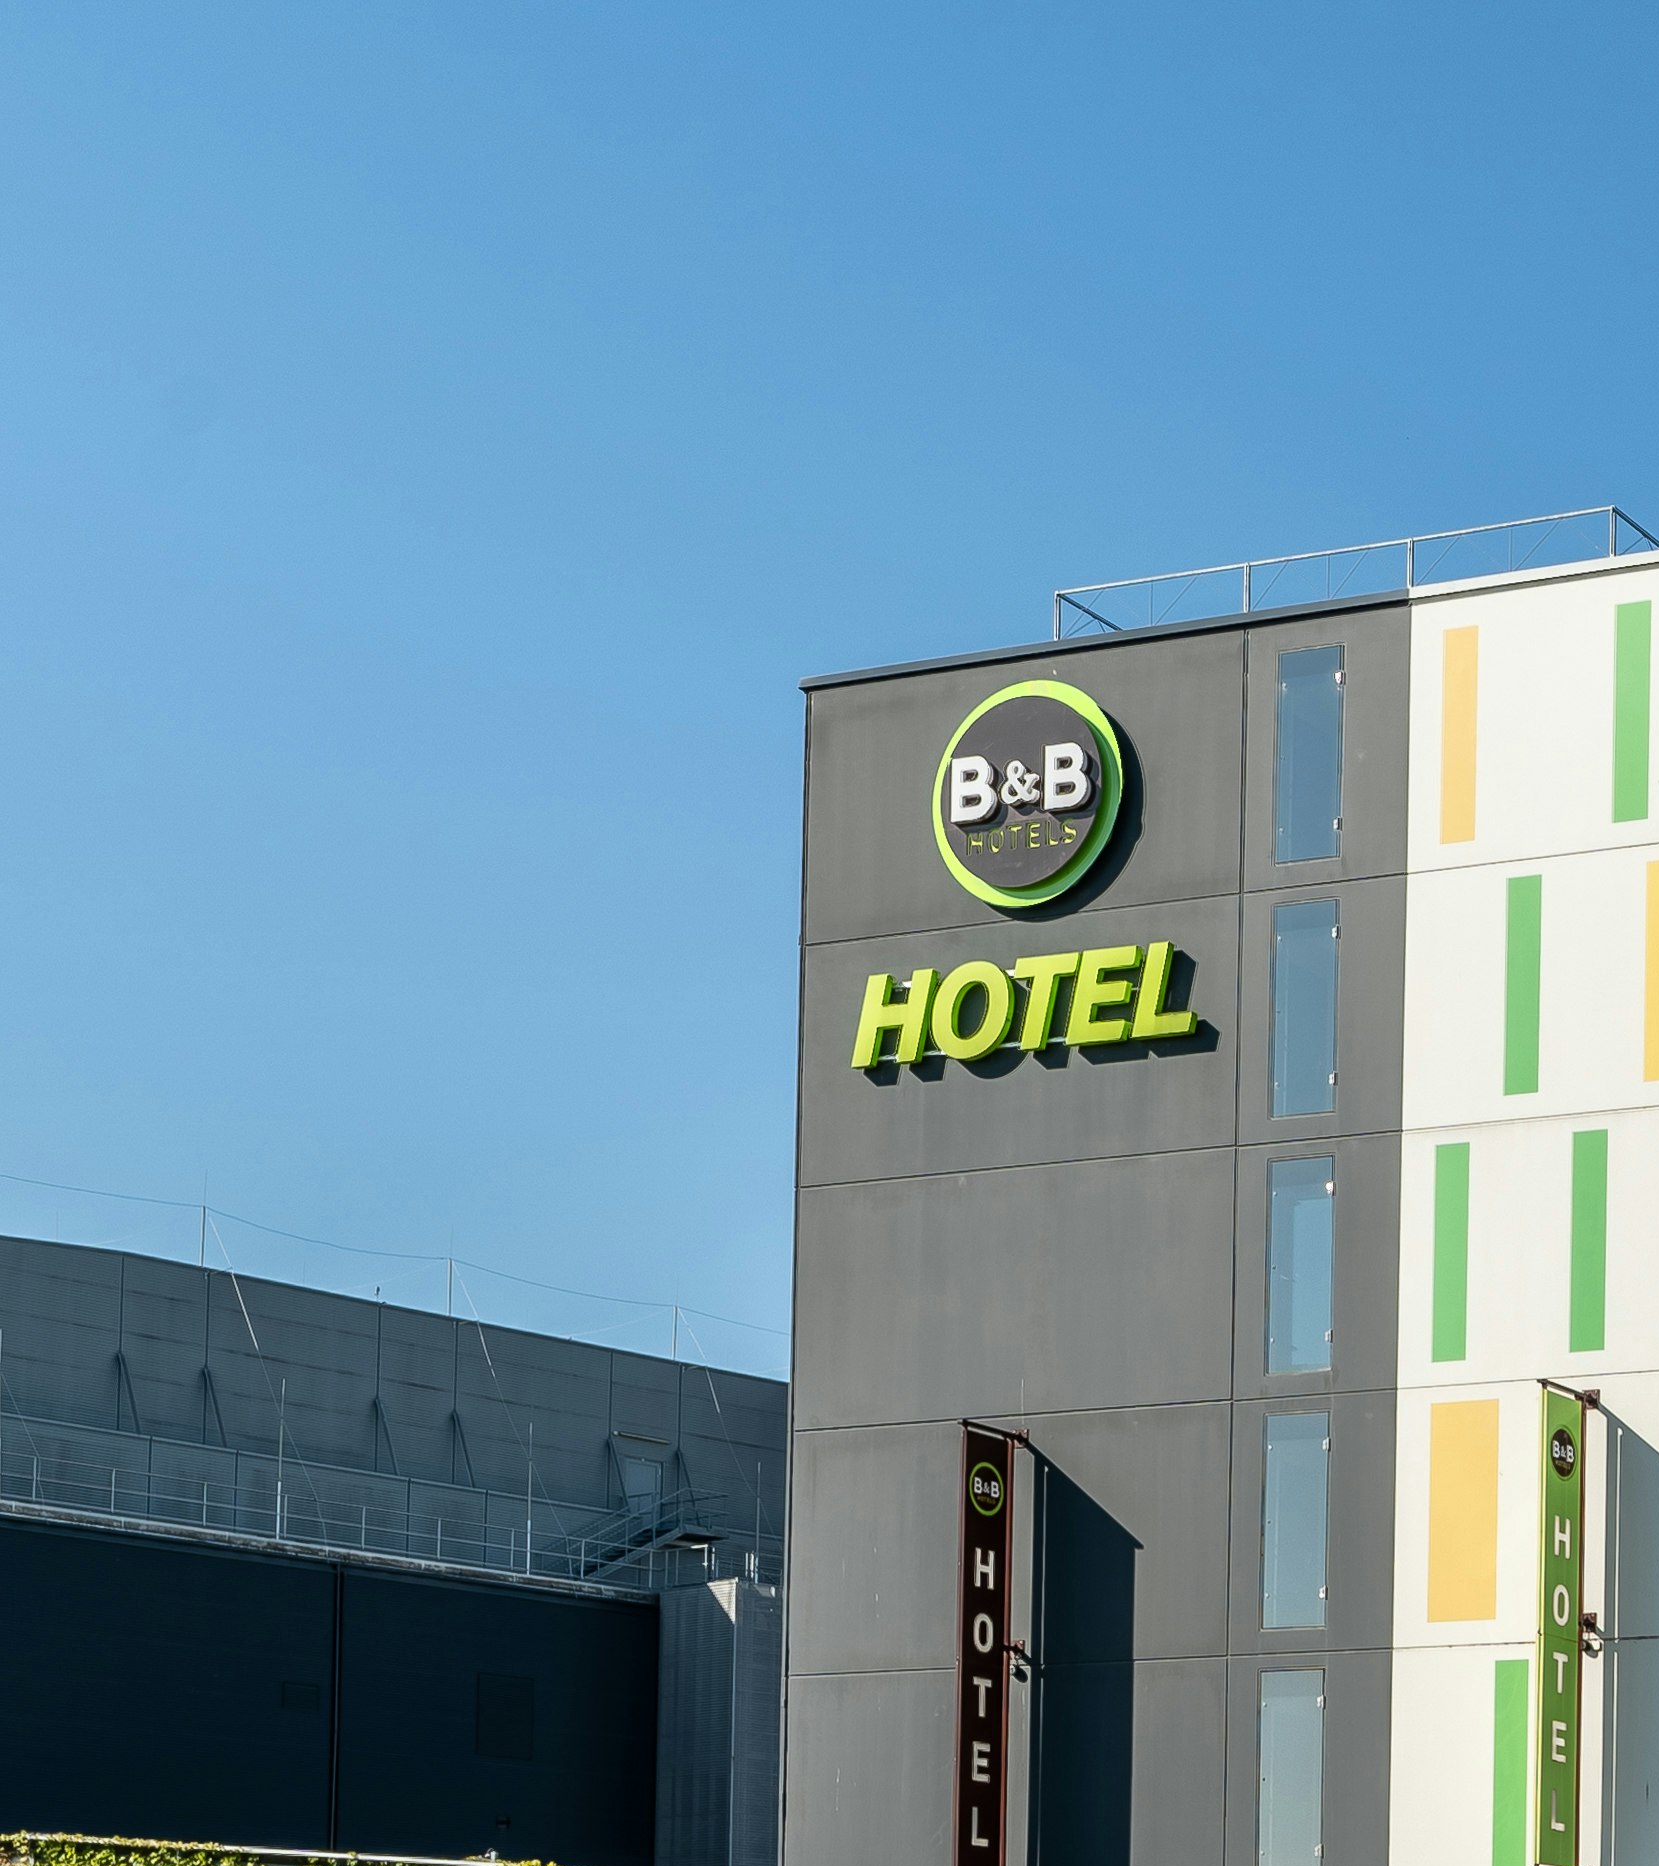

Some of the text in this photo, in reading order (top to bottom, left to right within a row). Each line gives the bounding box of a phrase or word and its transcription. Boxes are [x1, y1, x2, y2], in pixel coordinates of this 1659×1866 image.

[950, 741, 1090, 825] B&B
[966, 819, 1078, 857] HOTELS
[851, 941, 1199, 1070] HOTEL
[974, 1476, 1000, 1498] B&B
[1552, 1440, 1574, 1463] B&B
[971, 1547, 996, 1847] HOTEL
[1551, 1515, 1573, 1832] HOTEL
